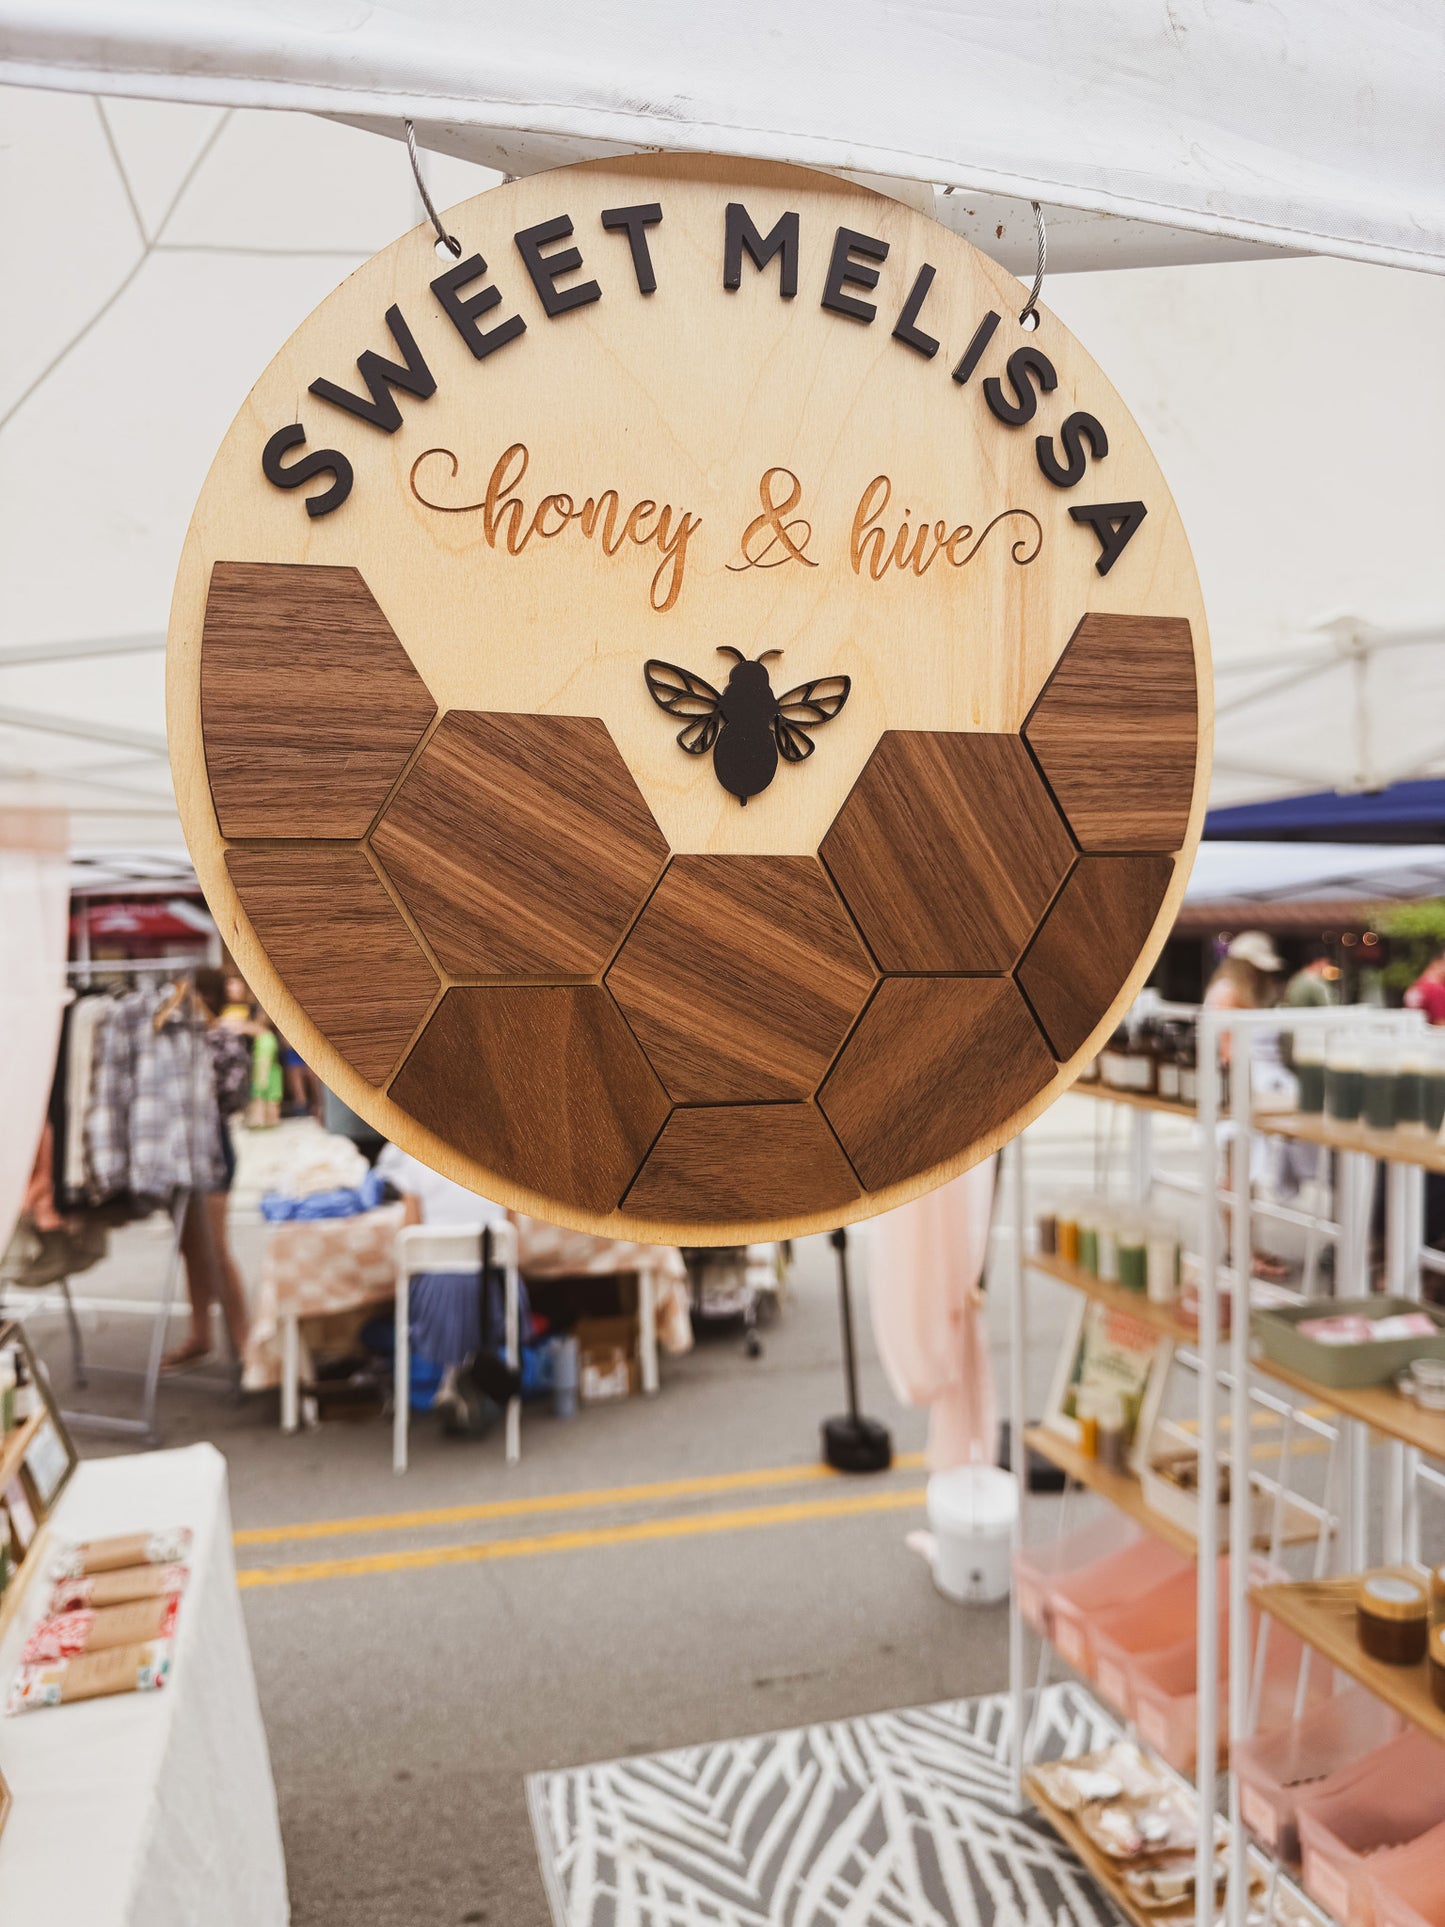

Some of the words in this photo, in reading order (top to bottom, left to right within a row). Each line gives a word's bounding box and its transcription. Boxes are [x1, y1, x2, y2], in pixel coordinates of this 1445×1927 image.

[262, 202, 663, 518] SWEET
[723, 202, 1148, 576] MELISSA
[409, 442, 702, 613] honey
[725, 466, 819, 573] &
[850, 474, 1043, 581] hive
